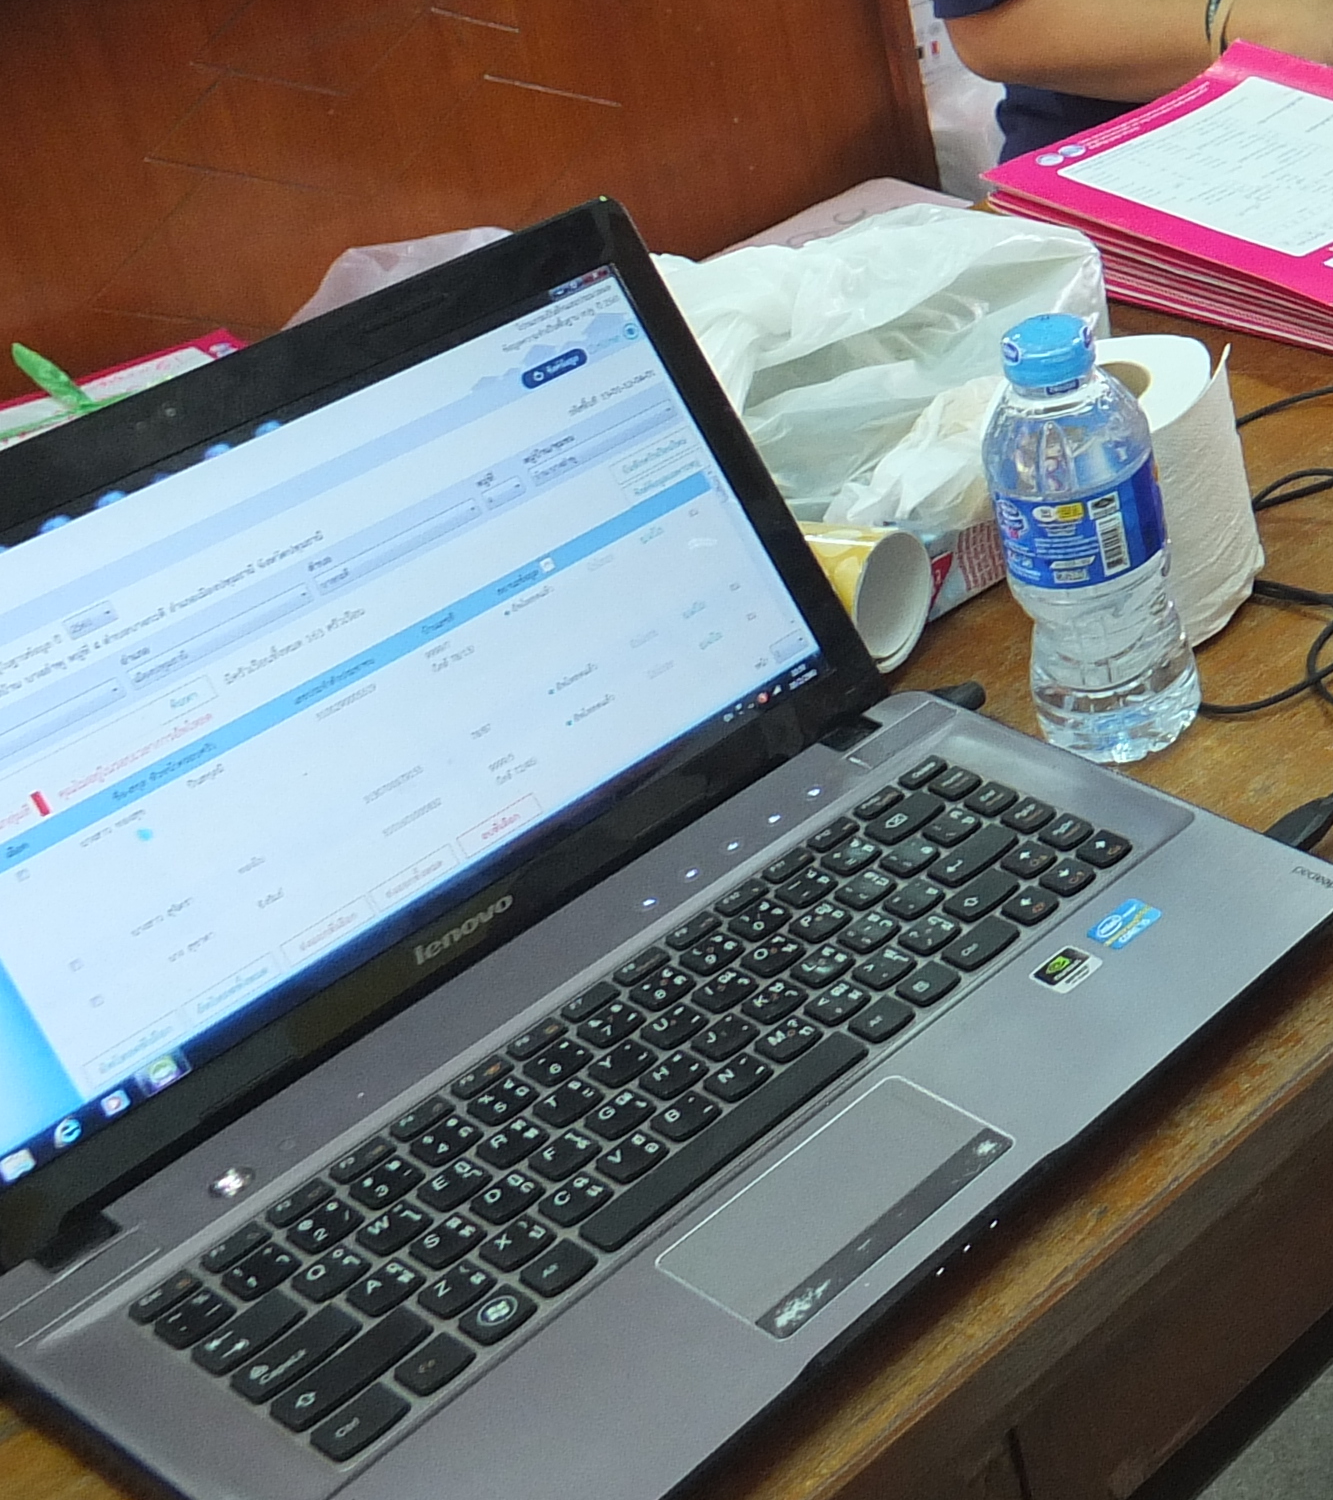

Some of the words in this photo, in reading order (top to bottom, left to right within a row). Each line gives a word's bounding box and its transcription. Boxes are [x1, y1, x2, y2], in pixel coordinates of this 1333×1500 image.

[800, 916, 820, 927] P
[413, 894, 514, 965] lenovo
[754, 948, 773, 960] O
[802, 963, 819, 971] L
[753, 995, 768, 1007] K
[601, 1025, 611, 1035] 7
[653, 1018, 674, 1031] U
[707, 1032, 716, 1043] J
[768, 1031, 789, 1045] M
[598, 1051, 611, 1068] Y
[550, 1064, 561, 1074] 6
[653, 1067, 669, 1080] H
[718, 1069, 734, 1083] N
[544, 1095, 556, 1107] T
[599, 1106, 615, 1120] G
[665, 1109, 680, 1122] B
[490, 1134, 507, 1148] R
[438, 1143, 448, 1153] 4
[543, 1147, 555, 1160] F
[607, 1150, 621, 1163] V
[432, 1176, 448, 1190] E
[375, 1185, 388, 1197] 3
[484, 1189, 501, 1203] D
[554, 1191, 570, 1205] C
[368, 1213, 389, 1234] W
[314, 1228, 327, 1241] 2
[424, 1234, 439, 1248] S
[494, 1234, 511, 1250] X
[307, 1265, 325, 1280] Q
[367, 1280, 381, 1294] A
[434, 1280, 450, 1297] Z
